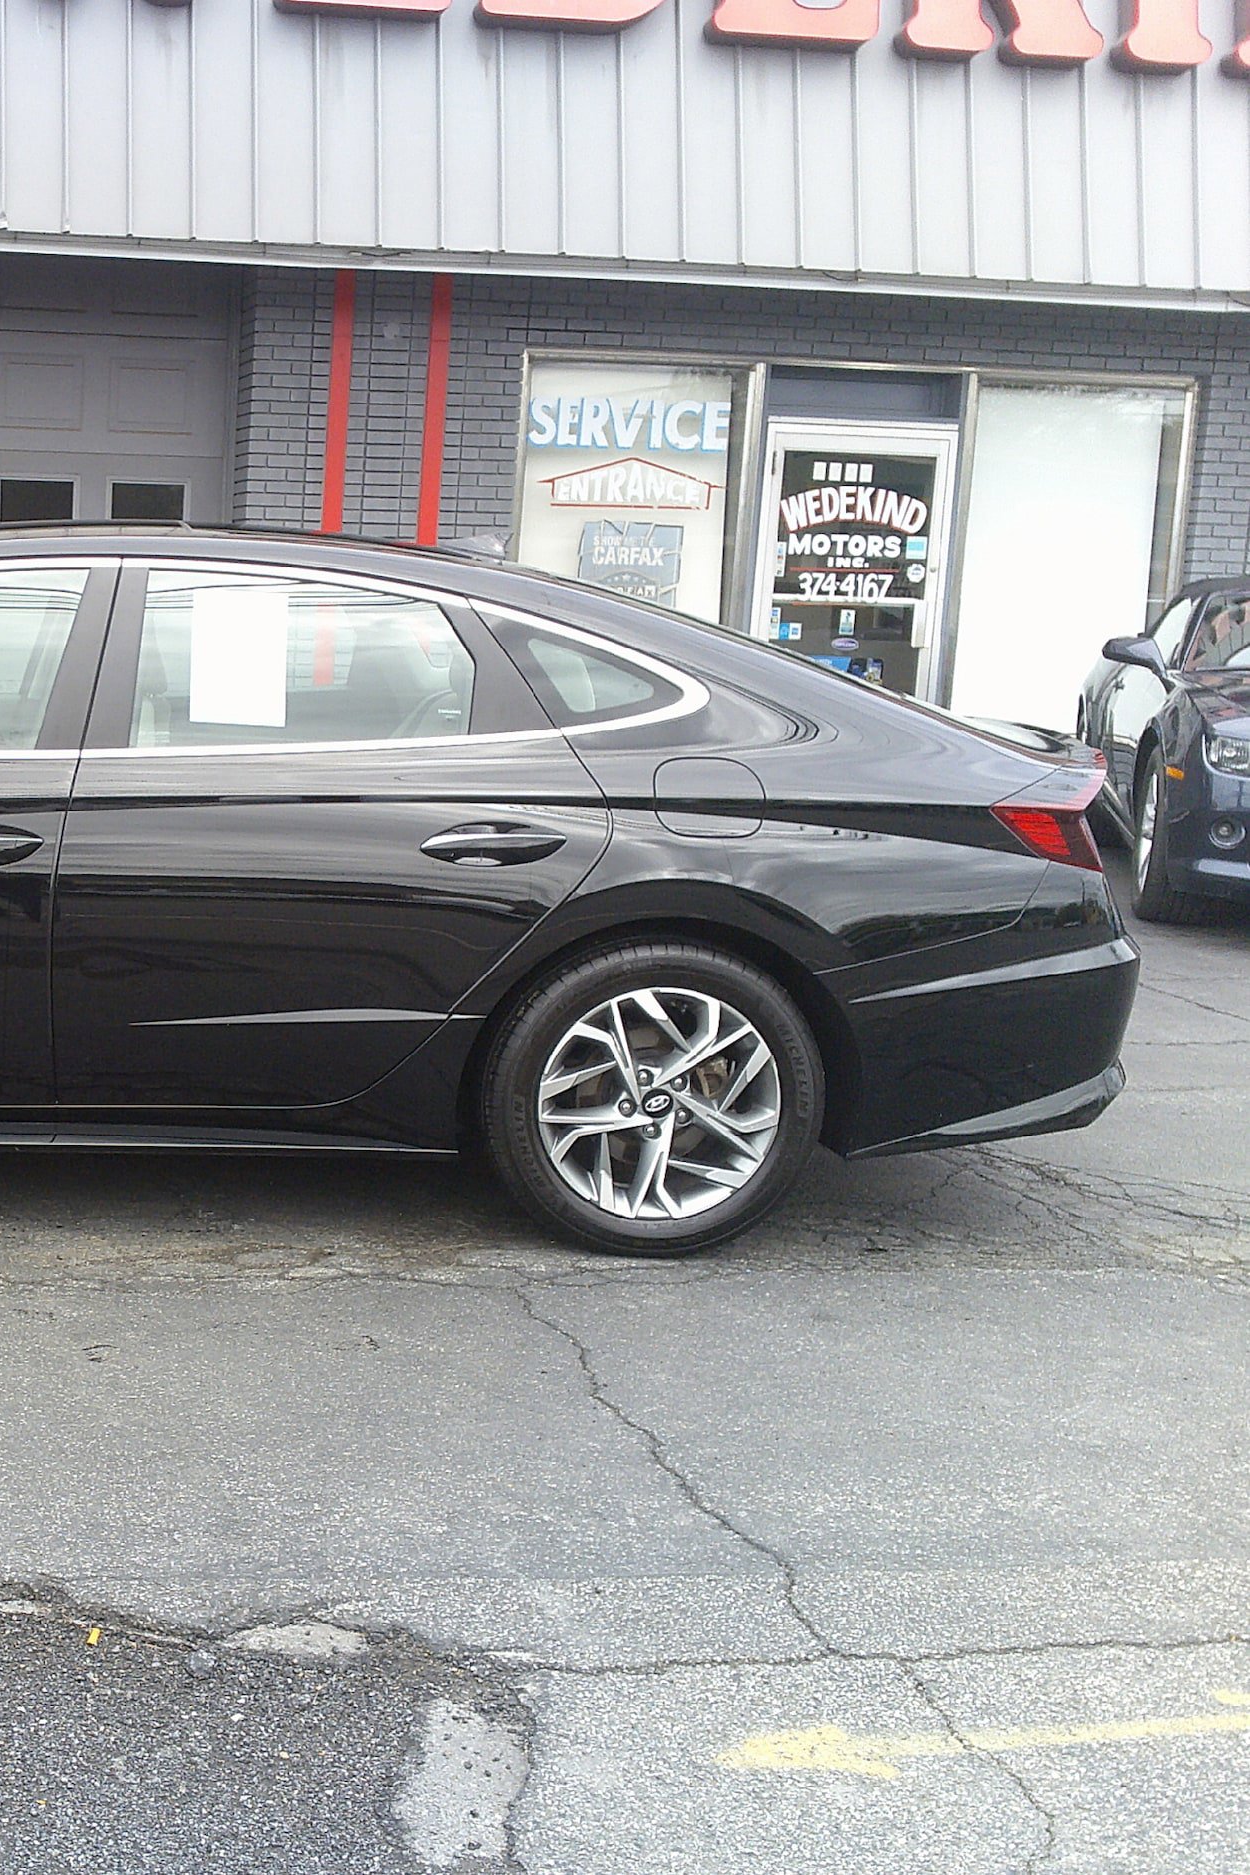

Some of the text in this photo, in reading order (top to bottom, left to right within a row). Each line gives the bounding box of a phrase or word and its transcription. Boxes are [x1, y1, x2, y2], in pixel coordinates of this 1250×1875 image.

[527, 397, 731, 452] SERVICE
[557, 461, 703, 505] ENTRANCE
[780, 485, 928, 534] WEDEKIND
[592, 545, 664, 566] CARFAX
[787, 533, 902, 558] MOTORS
[827, 556, 870, 568] INC.
